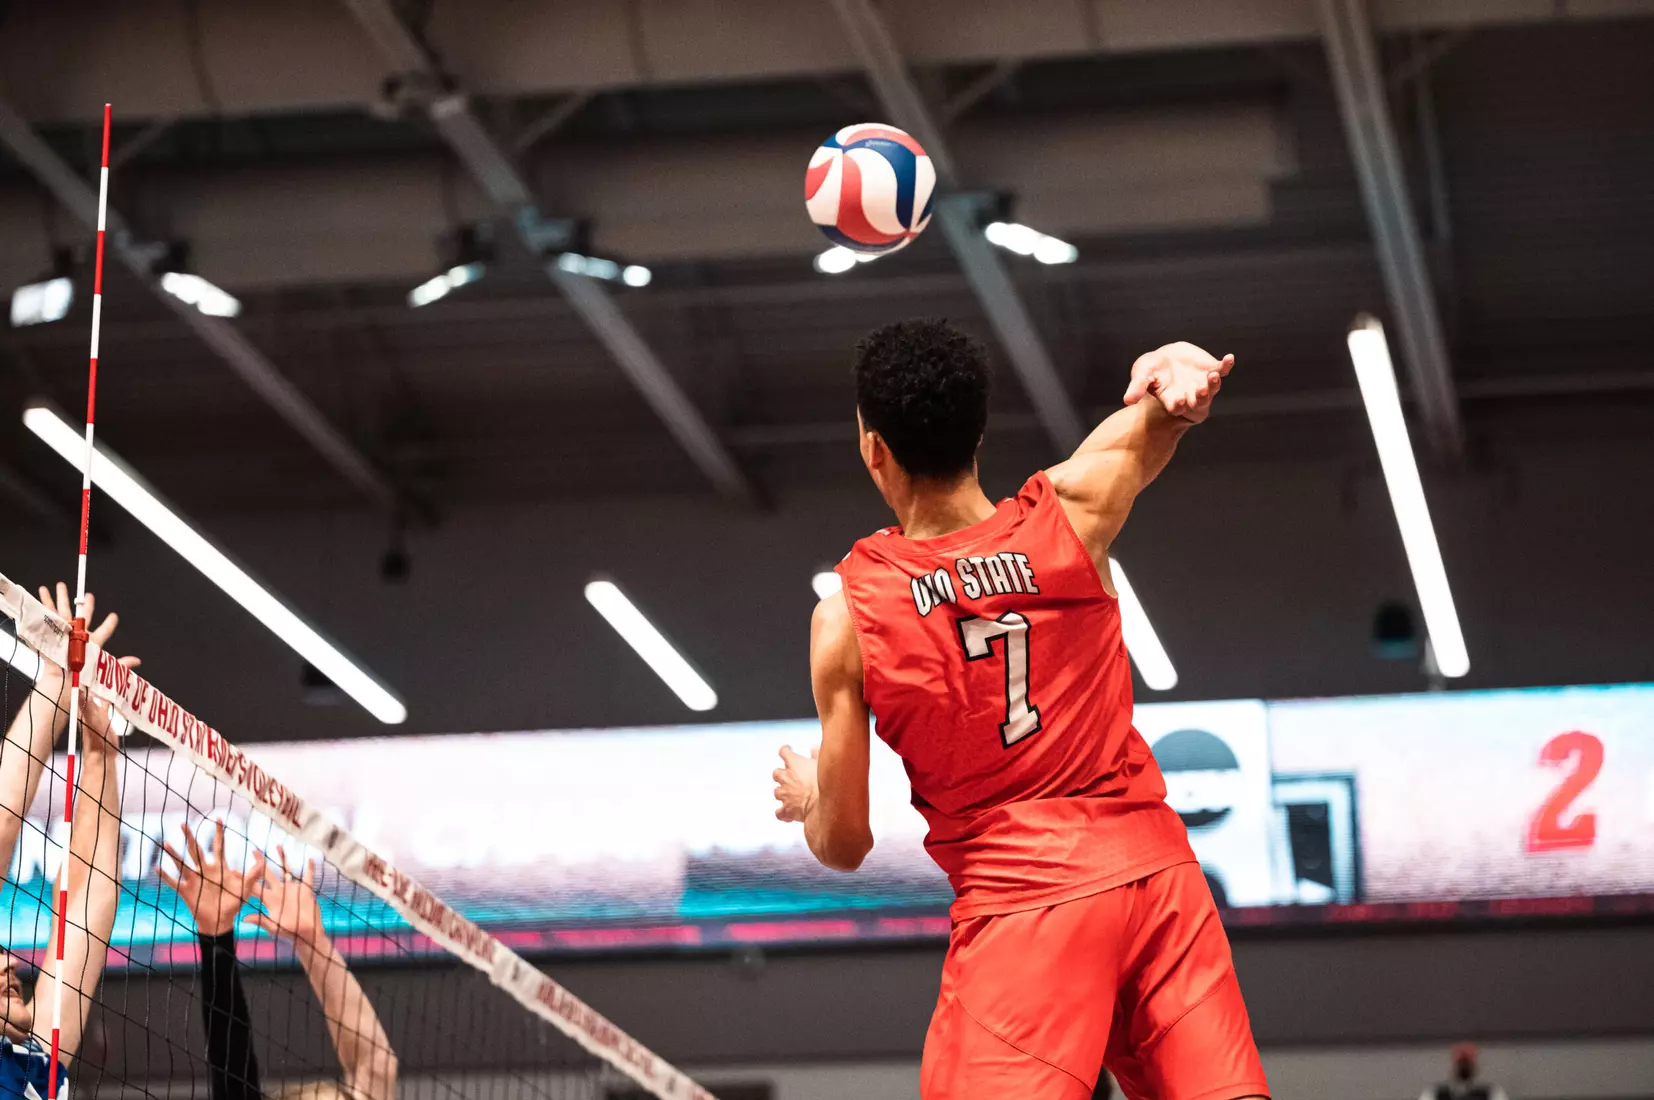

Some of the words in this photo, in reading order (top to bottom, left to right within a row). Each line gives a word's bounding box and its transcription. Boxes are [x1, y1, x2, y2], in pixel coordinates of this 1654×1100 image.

[955, 552, 1040, 600] STATE
[956, 609, 1042, 749] 7
[1527, 730, 1605, 853] 2
